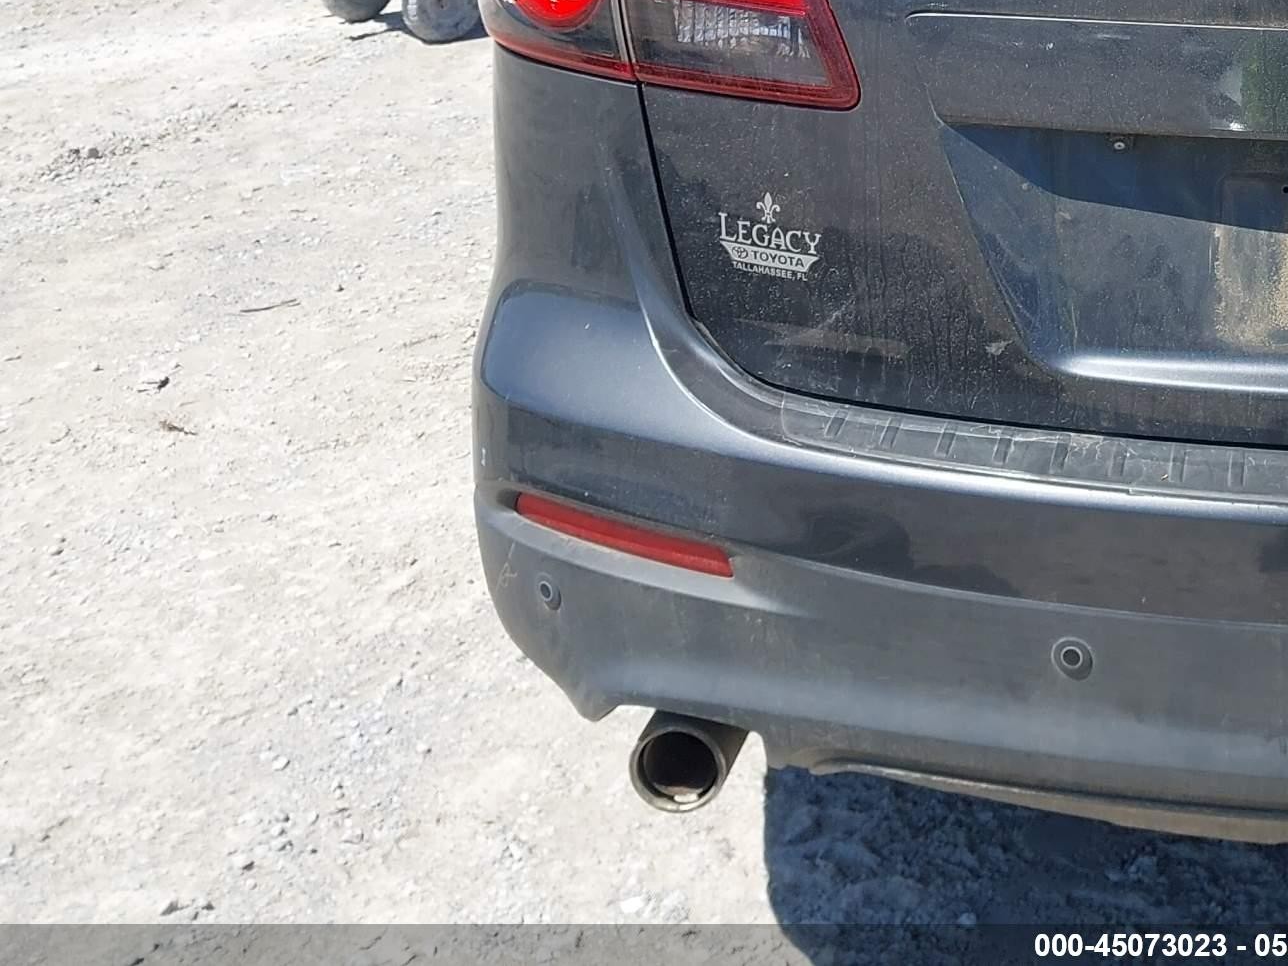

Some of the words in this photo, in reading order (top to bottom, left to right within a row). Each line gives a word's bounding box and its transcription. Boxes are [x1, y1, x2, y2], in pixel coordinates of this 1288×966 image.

[718, 212, 822, 254] LEGACY
[751, 250, 805, 268] TOYOTA
[796, 271, 808, 281] FL
